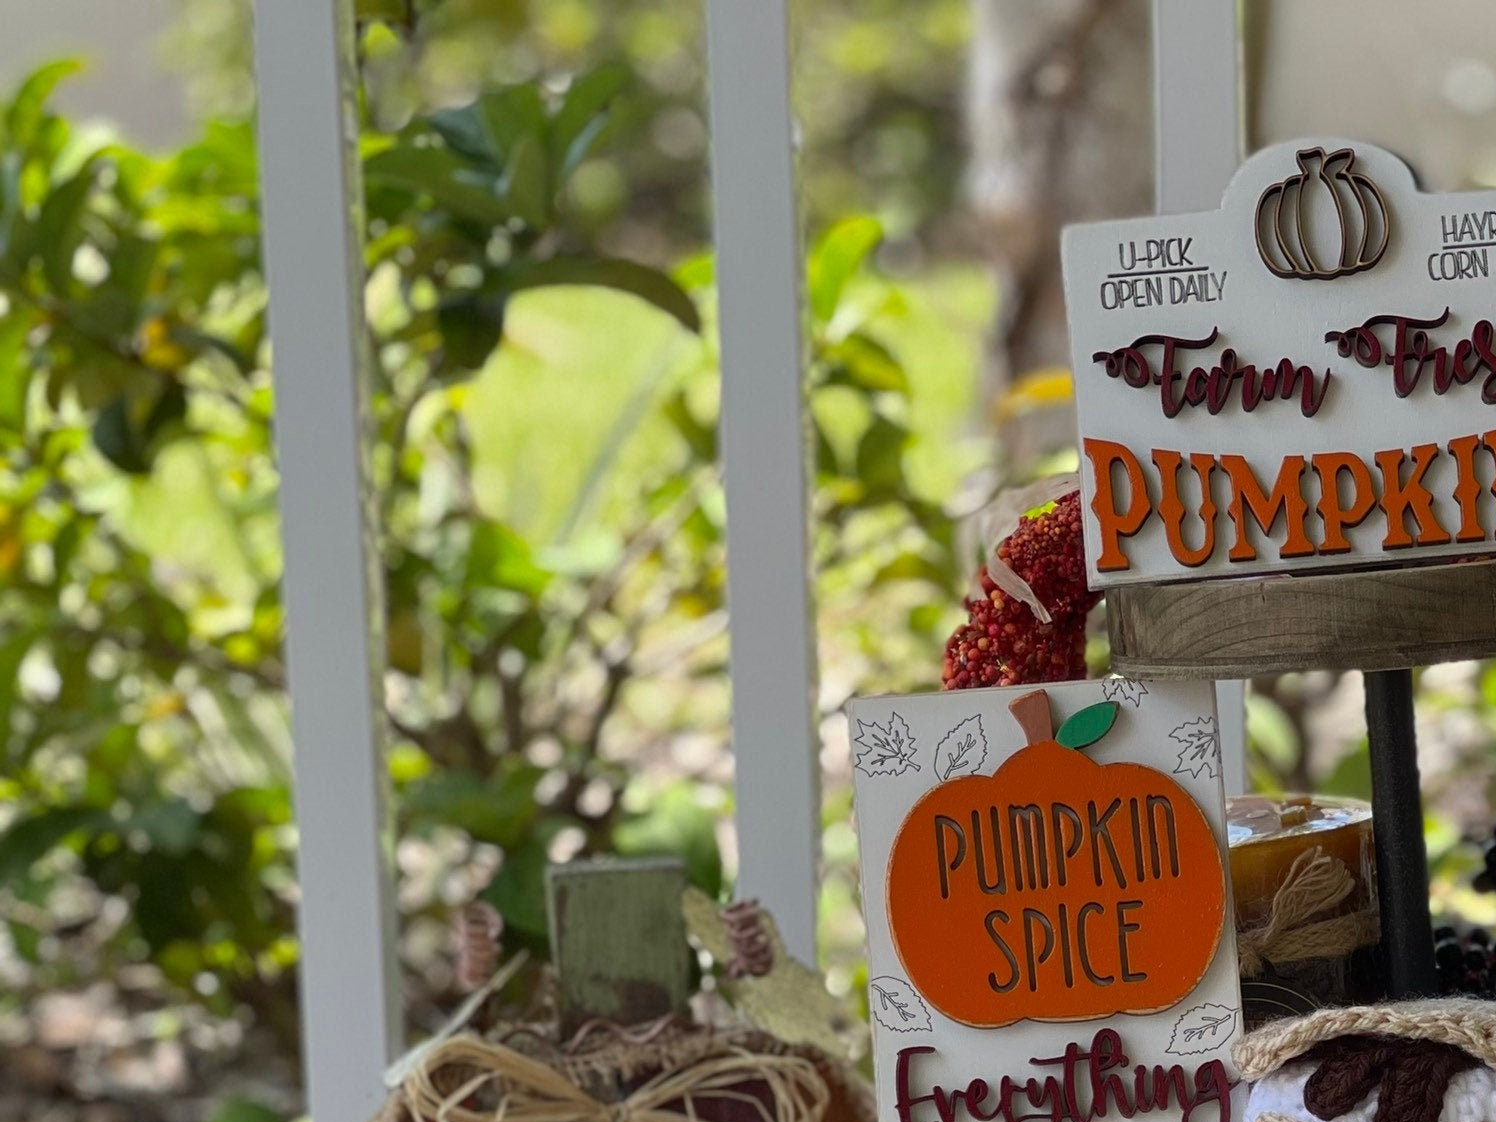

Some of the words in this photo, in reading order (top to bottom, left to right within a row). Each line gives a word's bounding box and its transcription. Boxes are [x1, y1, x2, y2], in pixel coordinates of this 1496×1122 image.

[1119, 238, 1193, 271] U-PICK
[1428, 249, 1490, 281] CORN
[1101, 276, 1163, 310] OPEN
[1169, 271, 1227, 304] DAILY
[1093, 326, 1331, 418] Farm
[934, 794, 1180, 899] PUMPKIN
[984, 901, 1147, 994] SPICE
